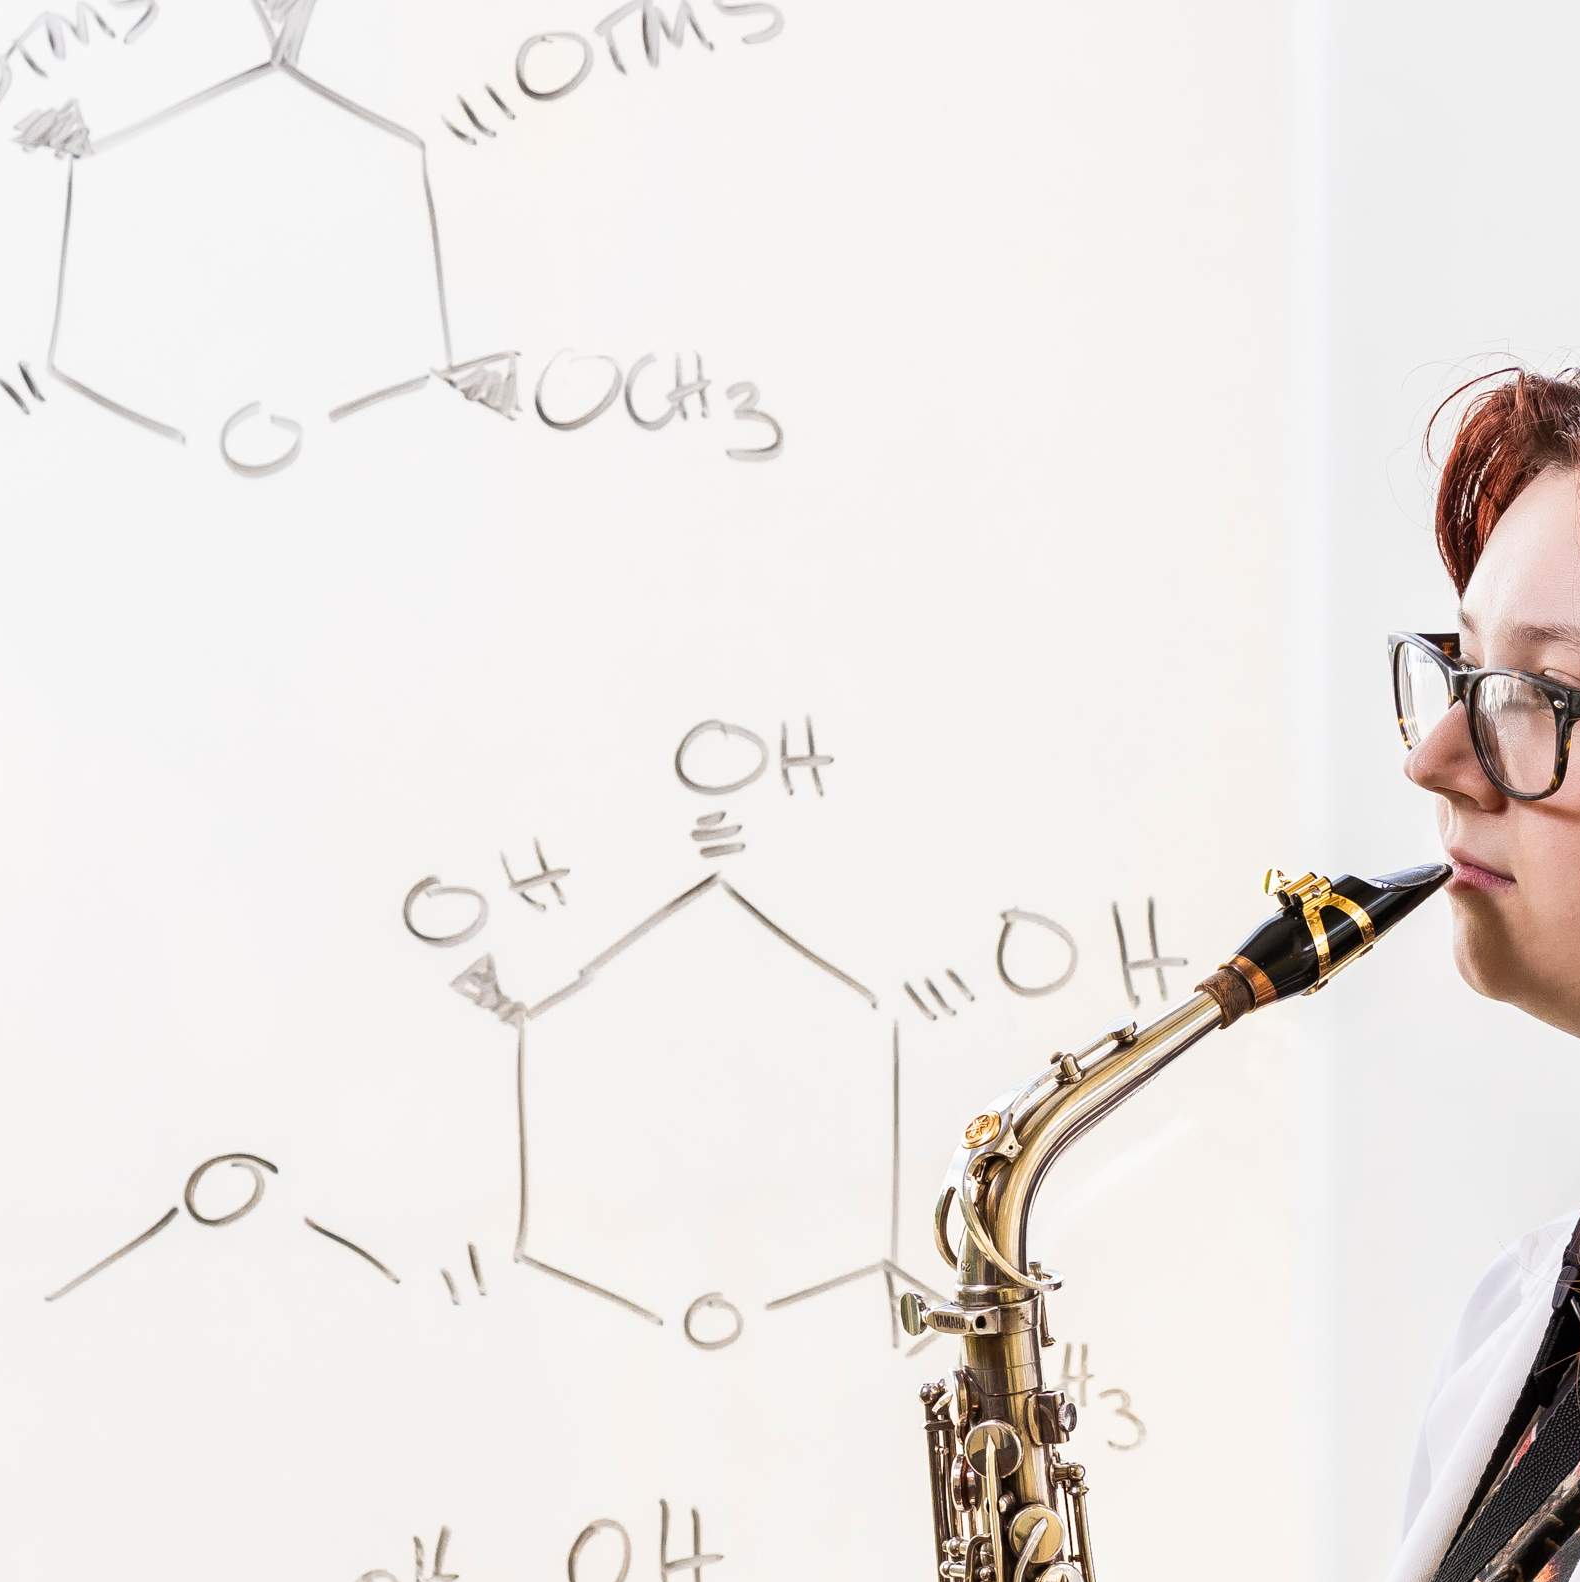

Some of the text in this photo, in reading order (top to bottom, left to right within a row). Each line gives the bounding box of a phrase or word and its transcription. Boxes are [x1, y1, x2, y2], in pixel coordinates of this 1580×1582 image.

[674, 715, 835, 797] OH
[402, 837, 571, 948] OH
[996, 896, 1190, 1008] OH
[934, 1312, 967, 1330] YAMAHA
[1054, 1342, 1147, 1450] H3
